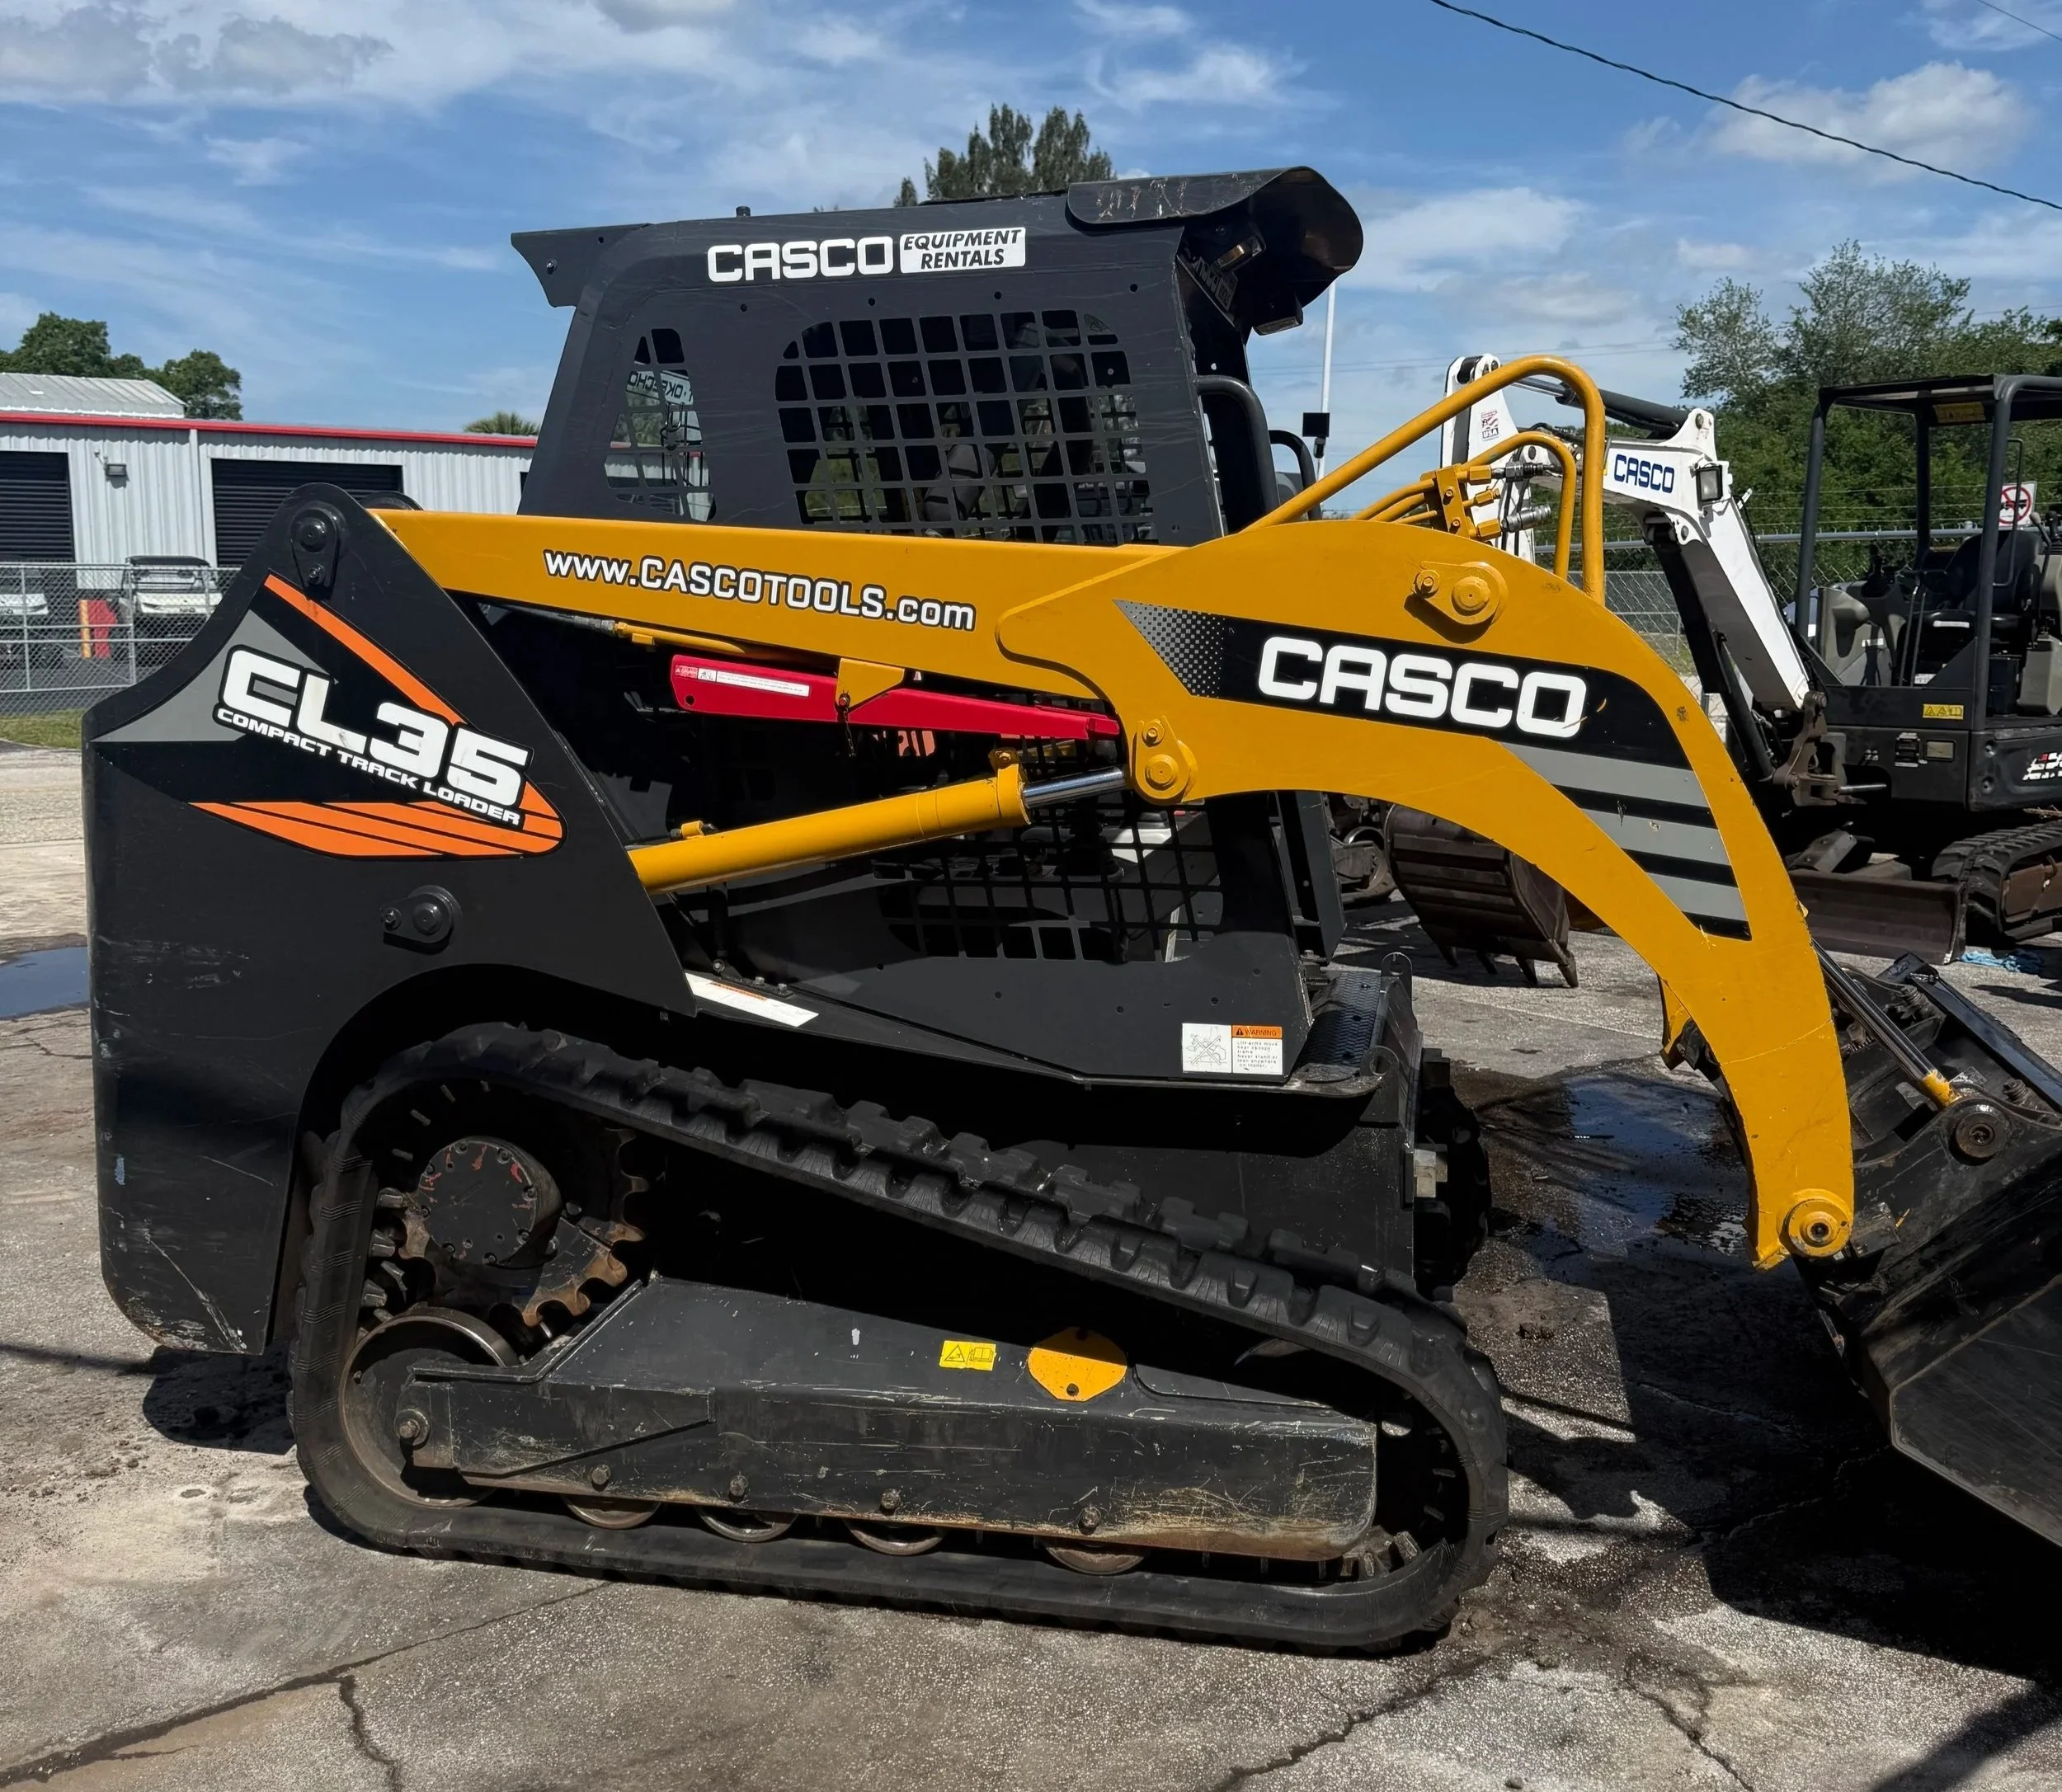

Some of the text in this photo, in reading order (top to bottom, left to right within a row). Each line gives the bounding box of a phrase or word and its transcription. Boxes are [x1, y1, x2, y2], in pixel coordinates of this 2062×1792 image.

[707, 236, 893, 282] CASCO
[904, 229, 1022, 251] EQUIPMENT
[920, 248, 1005, 270] RENTALS
[1483, 428, 1498, 438] USA
[1614, 454, 1675, 494] CASCO
[544, 552, 974, 630] www.CASCOTOOLS.com
[1258, 637, 1587, 738] CASCO
[223, 650, 530, 807] CL35
[217, 708, 522, 825] COMPACT TRACK LOADER
